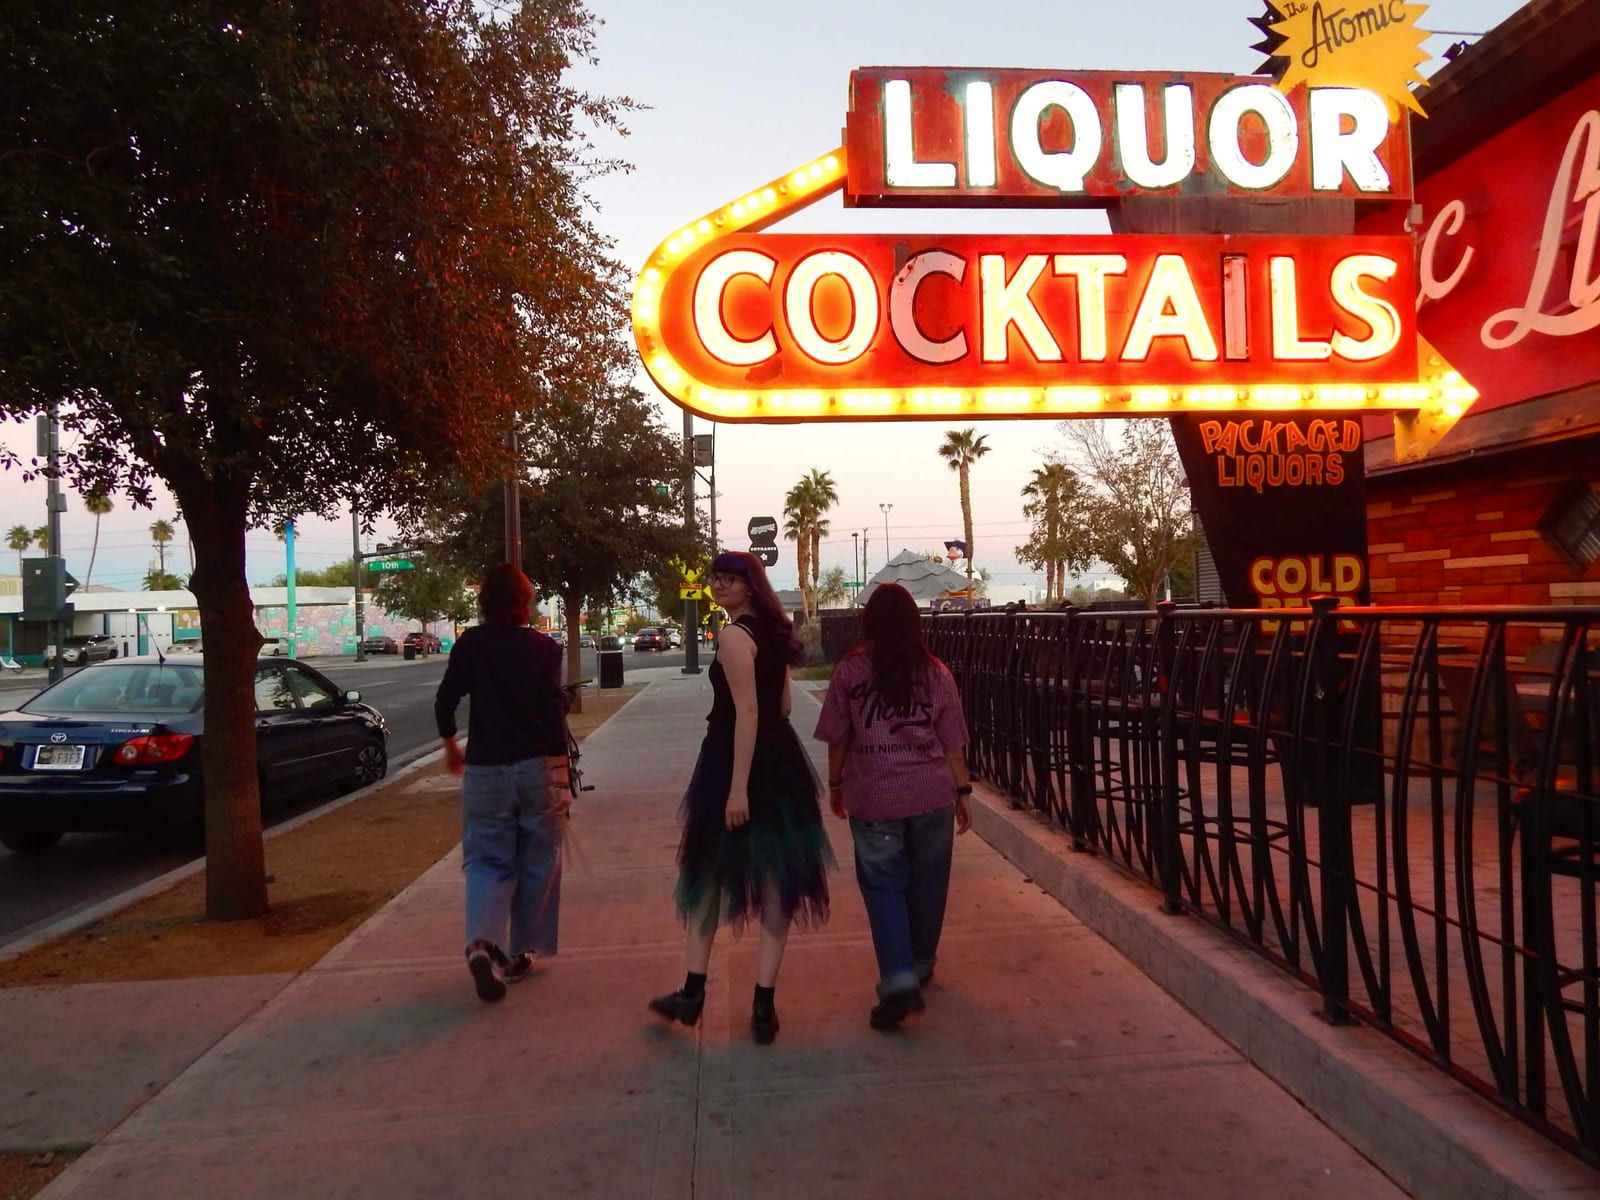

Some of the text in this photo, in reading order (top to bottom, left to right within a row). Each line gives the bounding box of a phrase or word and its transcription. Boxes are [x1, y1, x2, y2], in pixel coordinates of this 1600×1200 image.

[1283, 2, 1309, 18] The
[1301, 0, 1406, 68] Atomic
[884, 79, 1393, 192] LIQUOR
[692, 249, 1402, 366] COCKTAILS
[1199, 419, 1361, 458] PACKAGED
[1217, 453, 1344, 493] LIQUORS
[1252, 556, 1361, 594] COLD
[1260, 597, 1357, 632] BER
